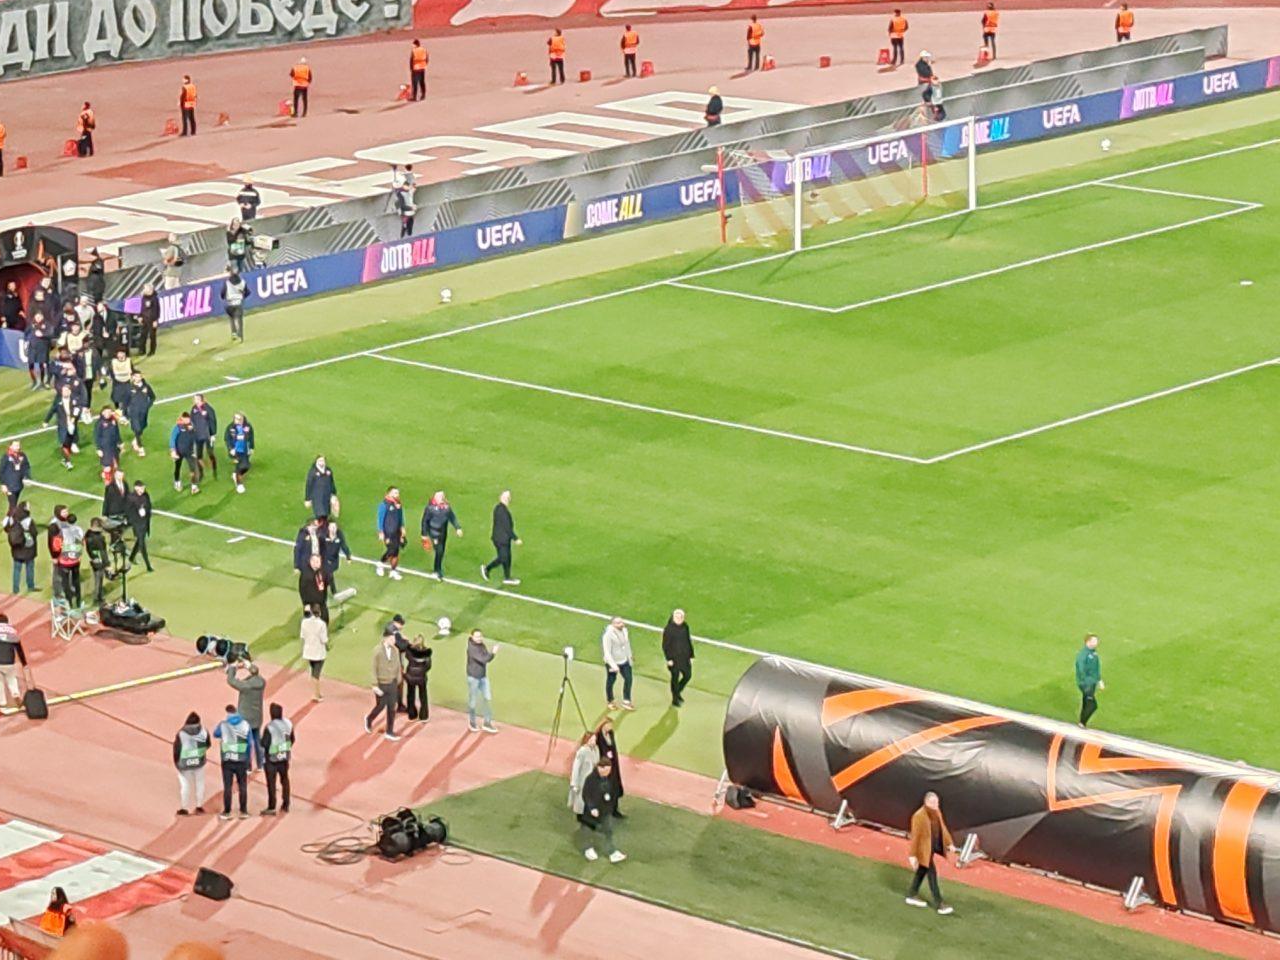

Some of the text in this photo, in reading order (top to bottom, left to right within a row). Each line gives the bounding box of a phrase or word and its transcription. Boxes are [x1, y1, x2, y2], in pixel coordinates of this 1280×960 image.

[1203, 71, 1239, 95] UEFA
[1042, 103, 1081, 129] UEFA
[868, 139, 909, 165] UEFA
[680, 177, 722, 206] UEFA
[618, 193, 643, 221] ALL
[477, 221, 524, 250] UEFA
[257, 267, 308, 298] UEFA
[184, 285, 212, 317] ALL
